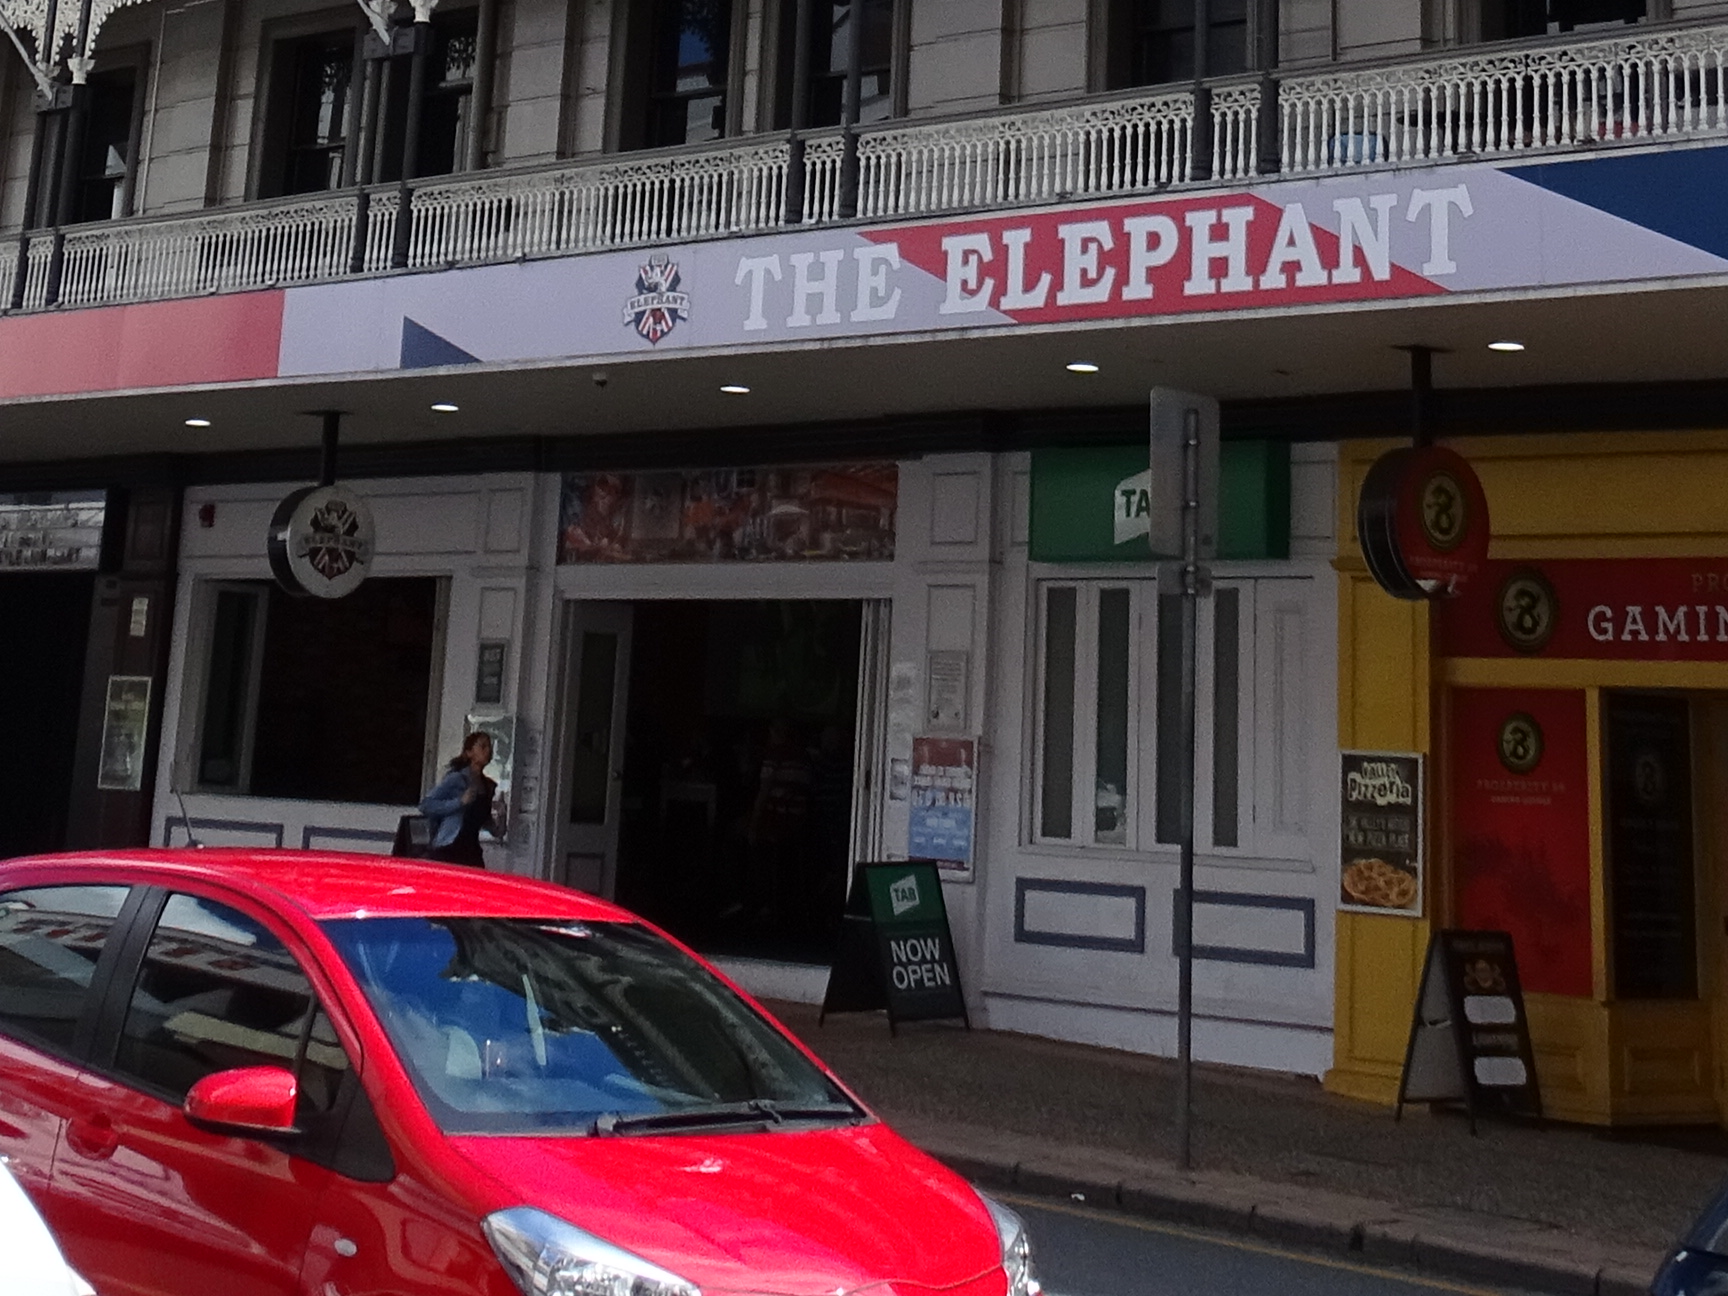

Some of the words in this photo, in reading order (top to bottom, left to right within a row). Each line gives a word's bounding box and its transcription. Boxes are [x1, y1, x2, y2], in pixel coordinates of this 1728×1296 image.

[734, 245, 902, 332] THE
[938, 182, 1475, 317] ELEPHANT
[629, 293, 686, 309] ELEPHANT
[1120, 488, 1151, 518] TA
[893, 886, 917, 903] TAB
[890, 936, 940, 964] NOW
[892, 962, 952, 990] OPEN
